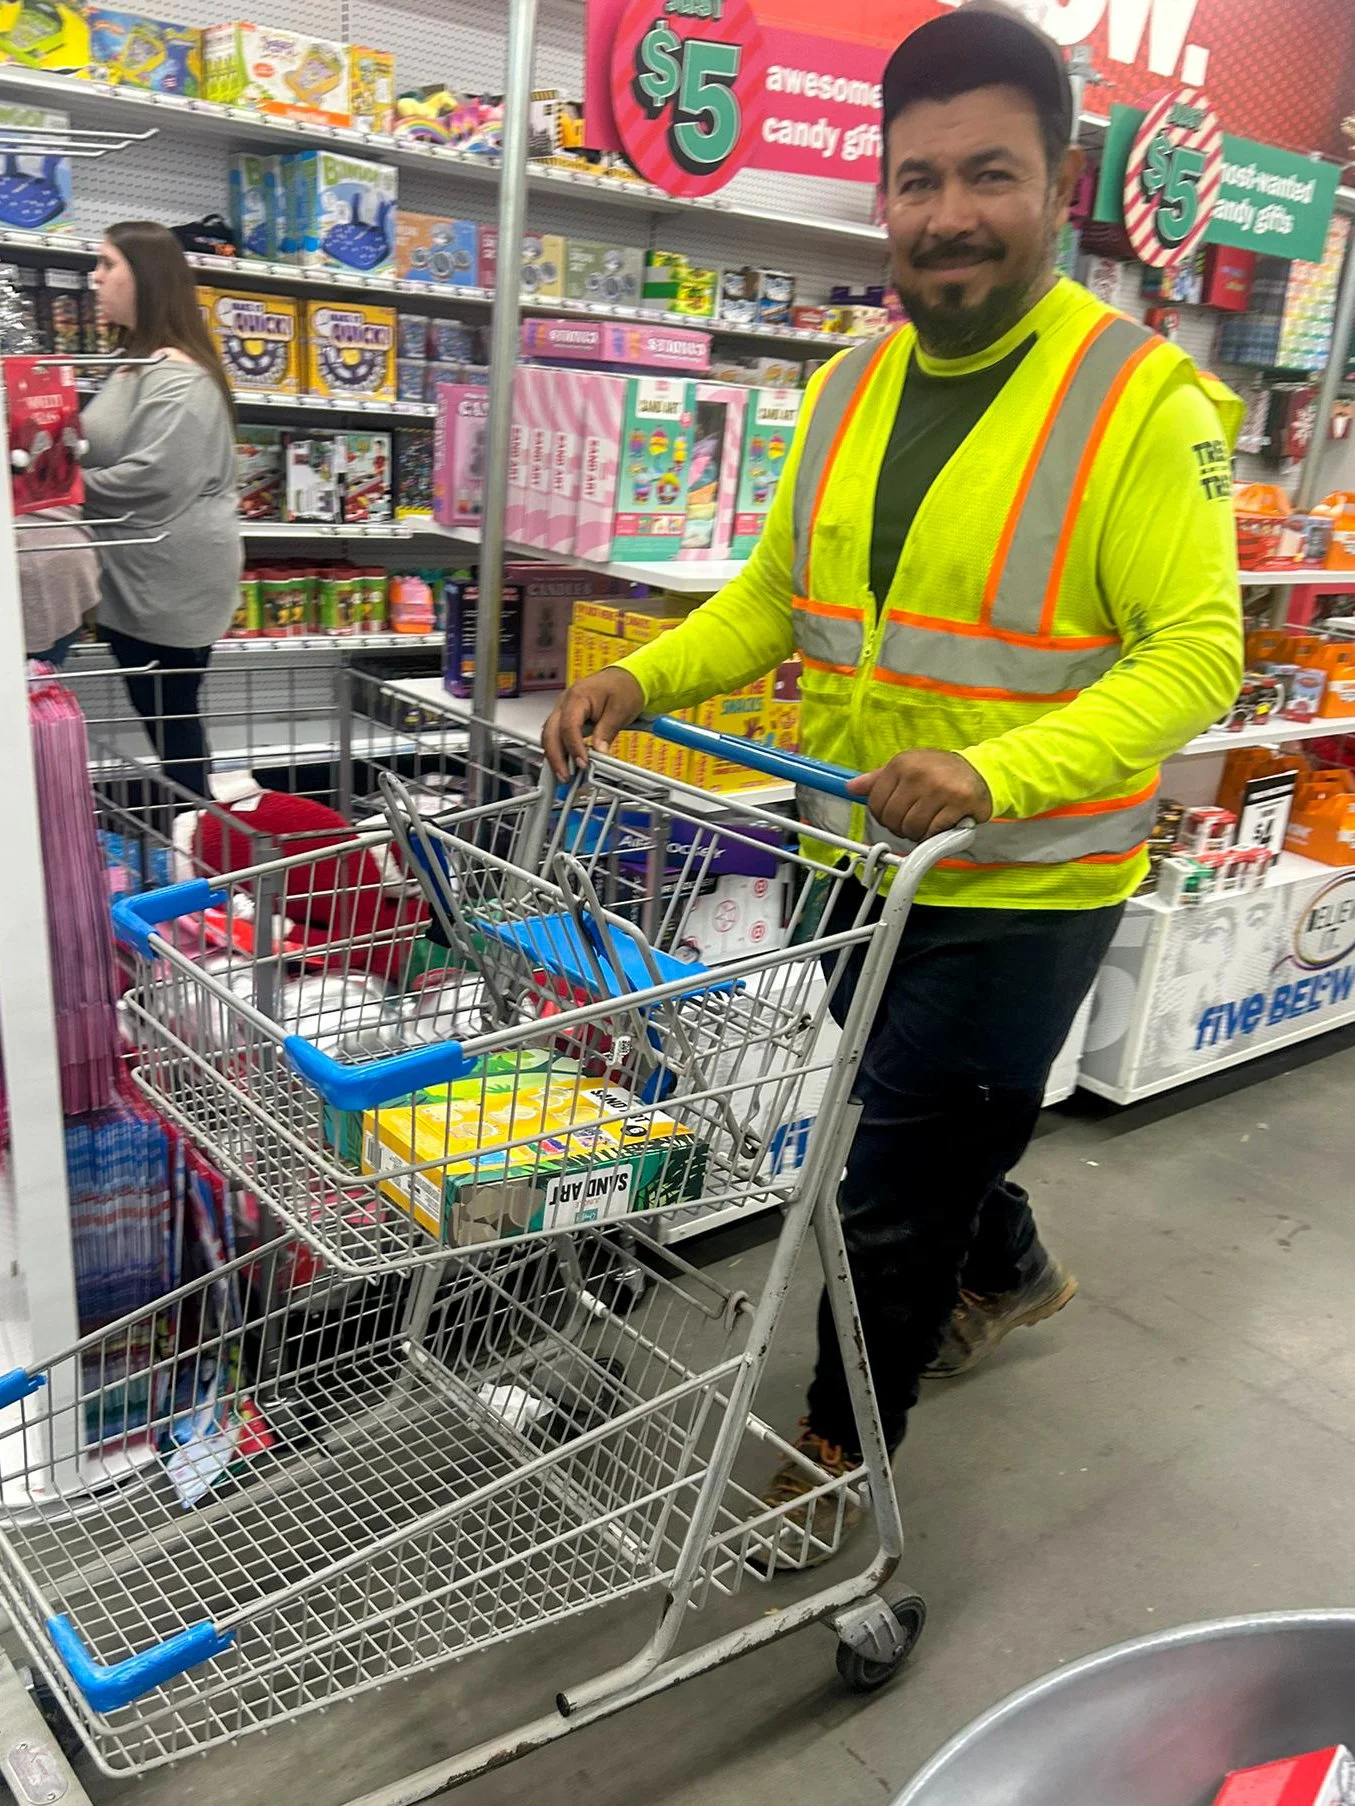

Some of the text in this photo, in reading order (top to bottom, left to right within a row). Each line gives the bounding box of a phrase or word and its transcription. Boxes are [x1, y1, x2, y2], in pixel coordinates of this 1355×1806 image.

[639, 20, 742, 163] $5
[765, 65, 884, 109] awesome
[762, 117, 842, 158] candy
[1141, 131, 1208, 241] $5
[1211, 197, 1295, 234] andy gifts
[664, 842, 727, 859] ocey
[1194, 992, 1266, 1051] five
[548, 1172, 629, 1207] SAND ART
